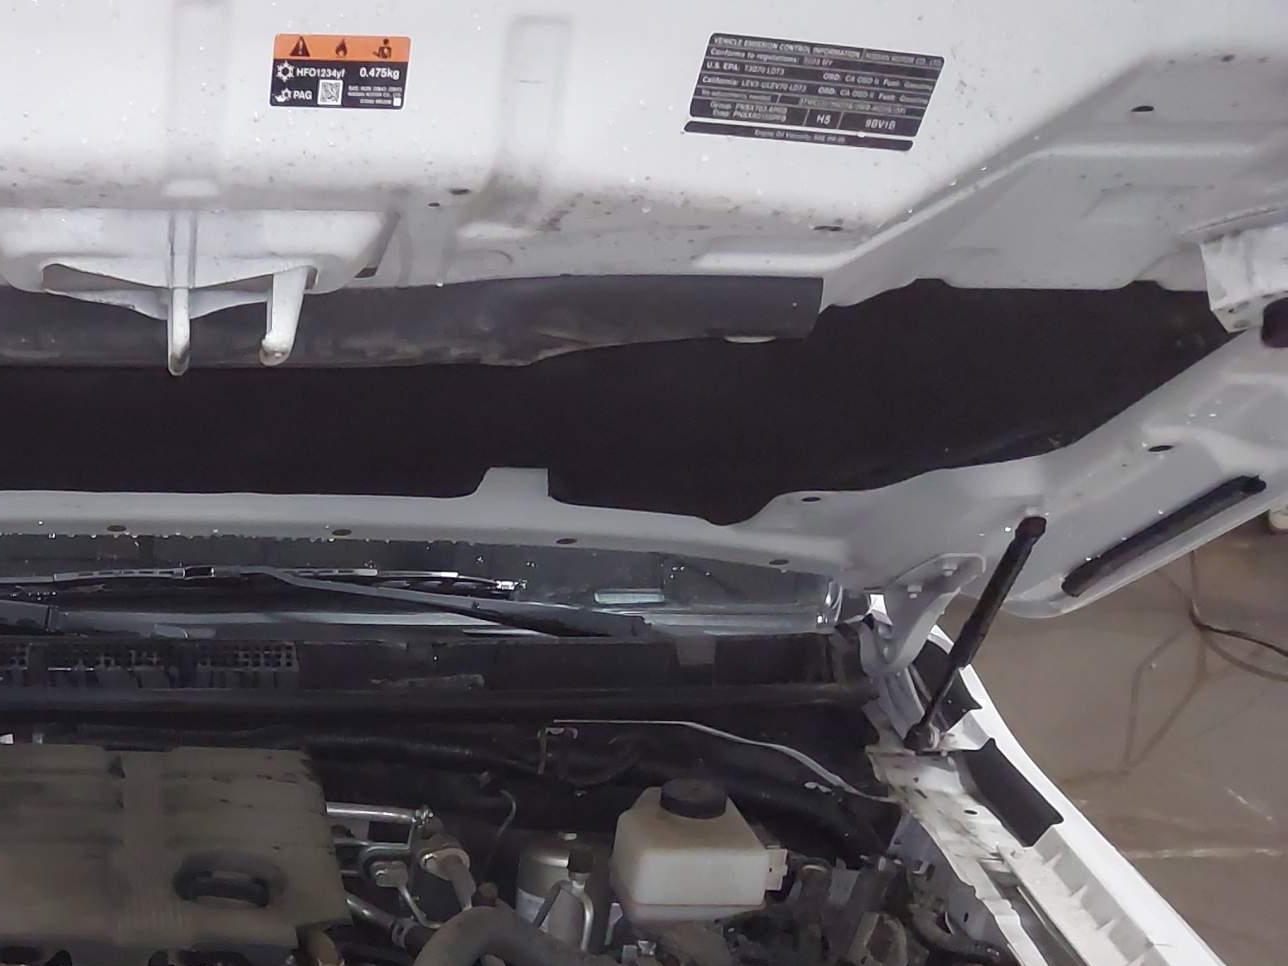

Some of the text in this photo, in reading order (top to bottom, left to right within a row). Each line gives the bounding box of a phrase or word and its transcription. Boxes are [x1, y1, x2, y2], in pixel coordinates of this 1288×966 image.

[296, 67, 400, 80] HFO1234yf 0.475kg
[293, 90, 313, 99] PAG
